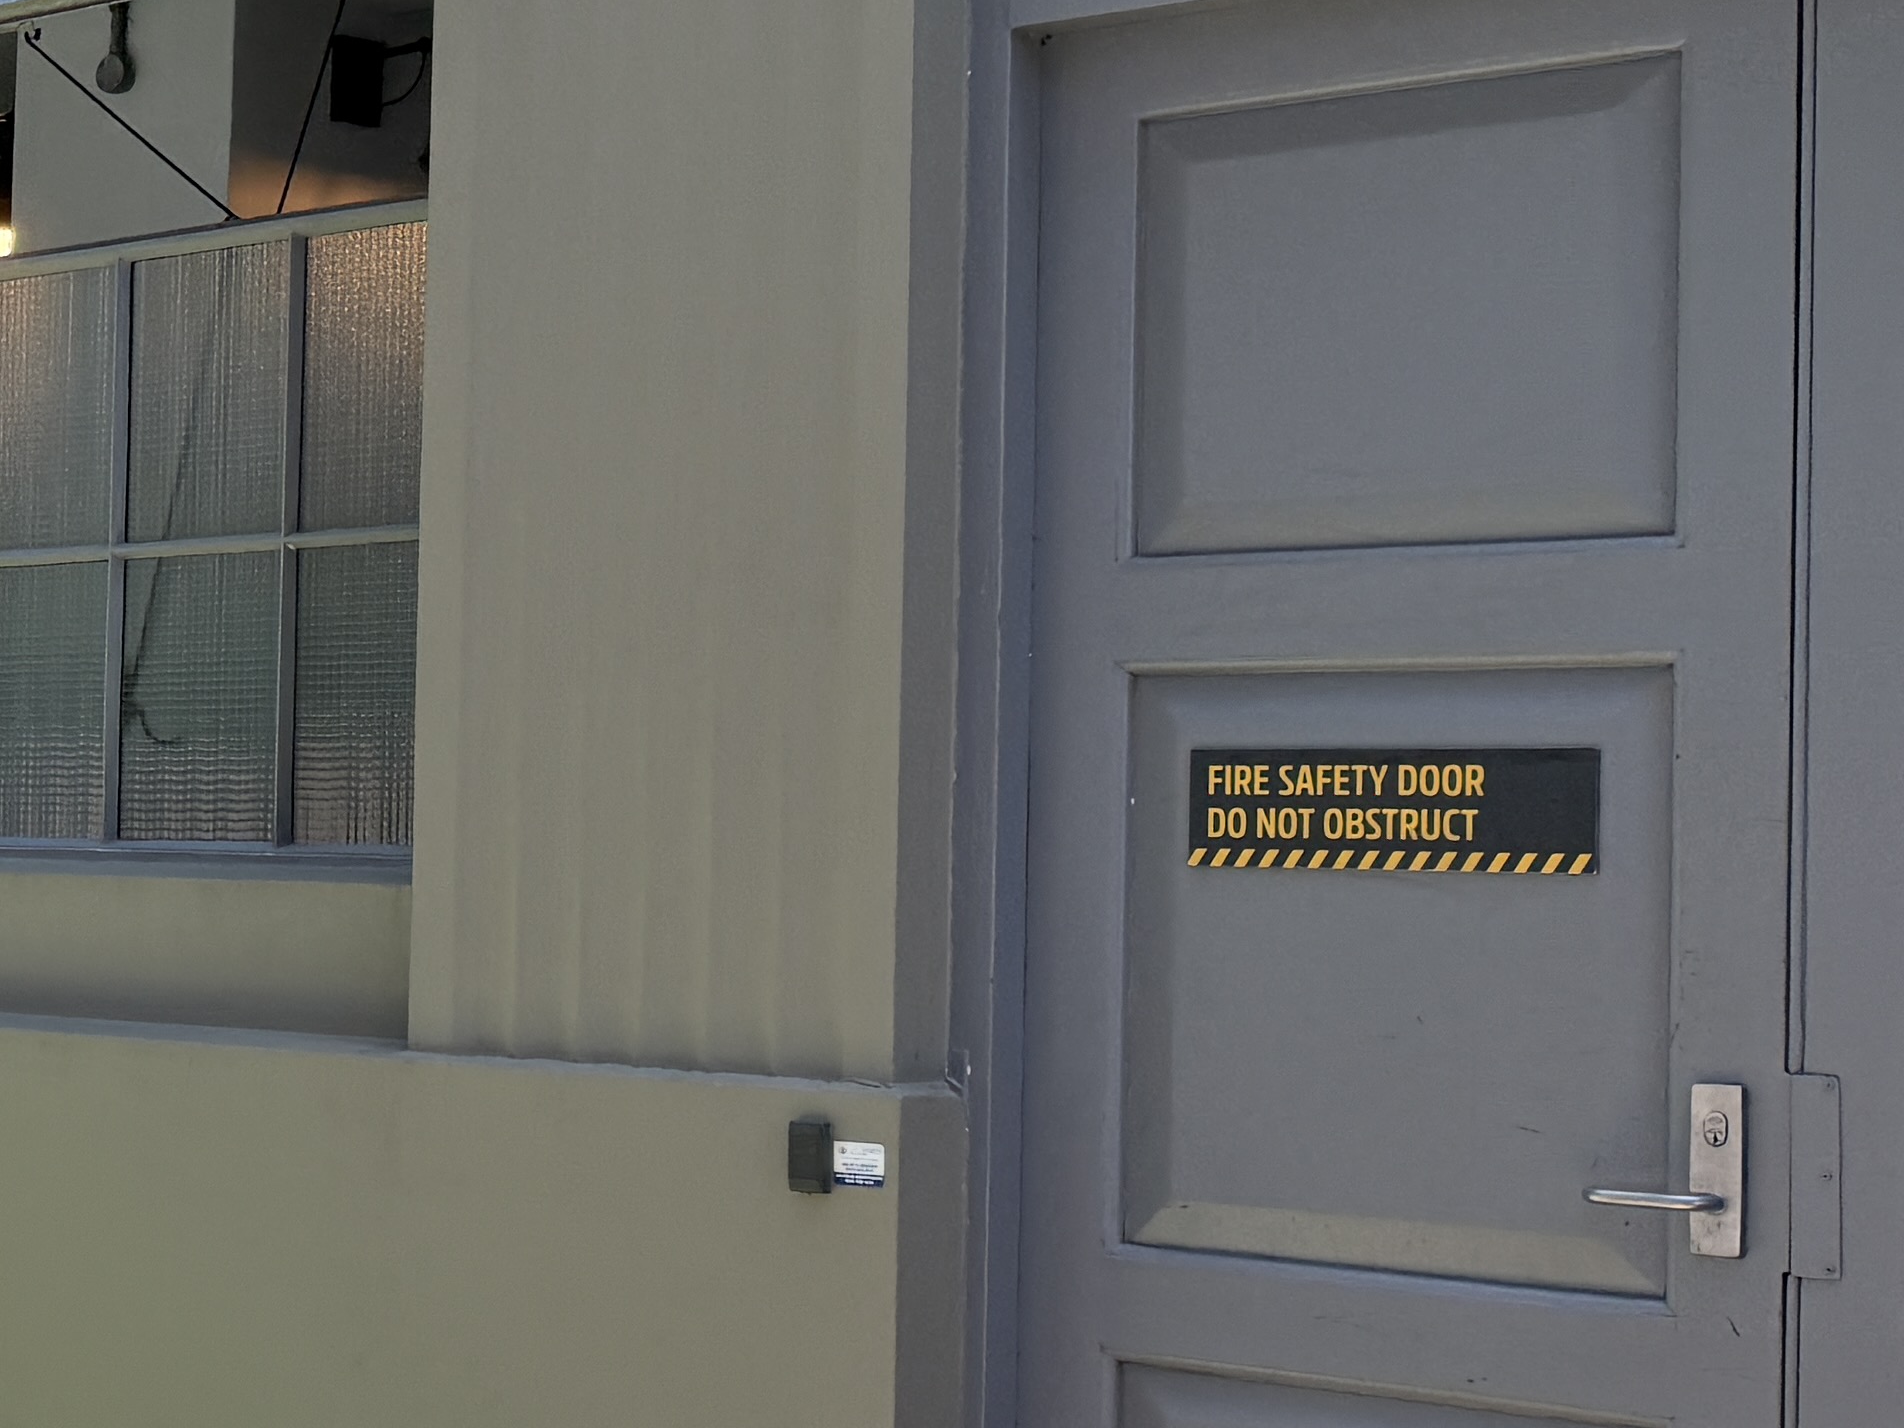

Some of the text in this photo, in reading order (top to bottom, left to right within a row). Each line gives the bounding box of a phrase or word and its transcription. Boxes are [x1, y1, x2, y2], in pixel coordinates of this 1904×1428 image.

[1208, 764, 1485, 797] FIRE SAFETY DOOR
[1207, 807, 1480, 842] DO NOT OBSTRUCT
